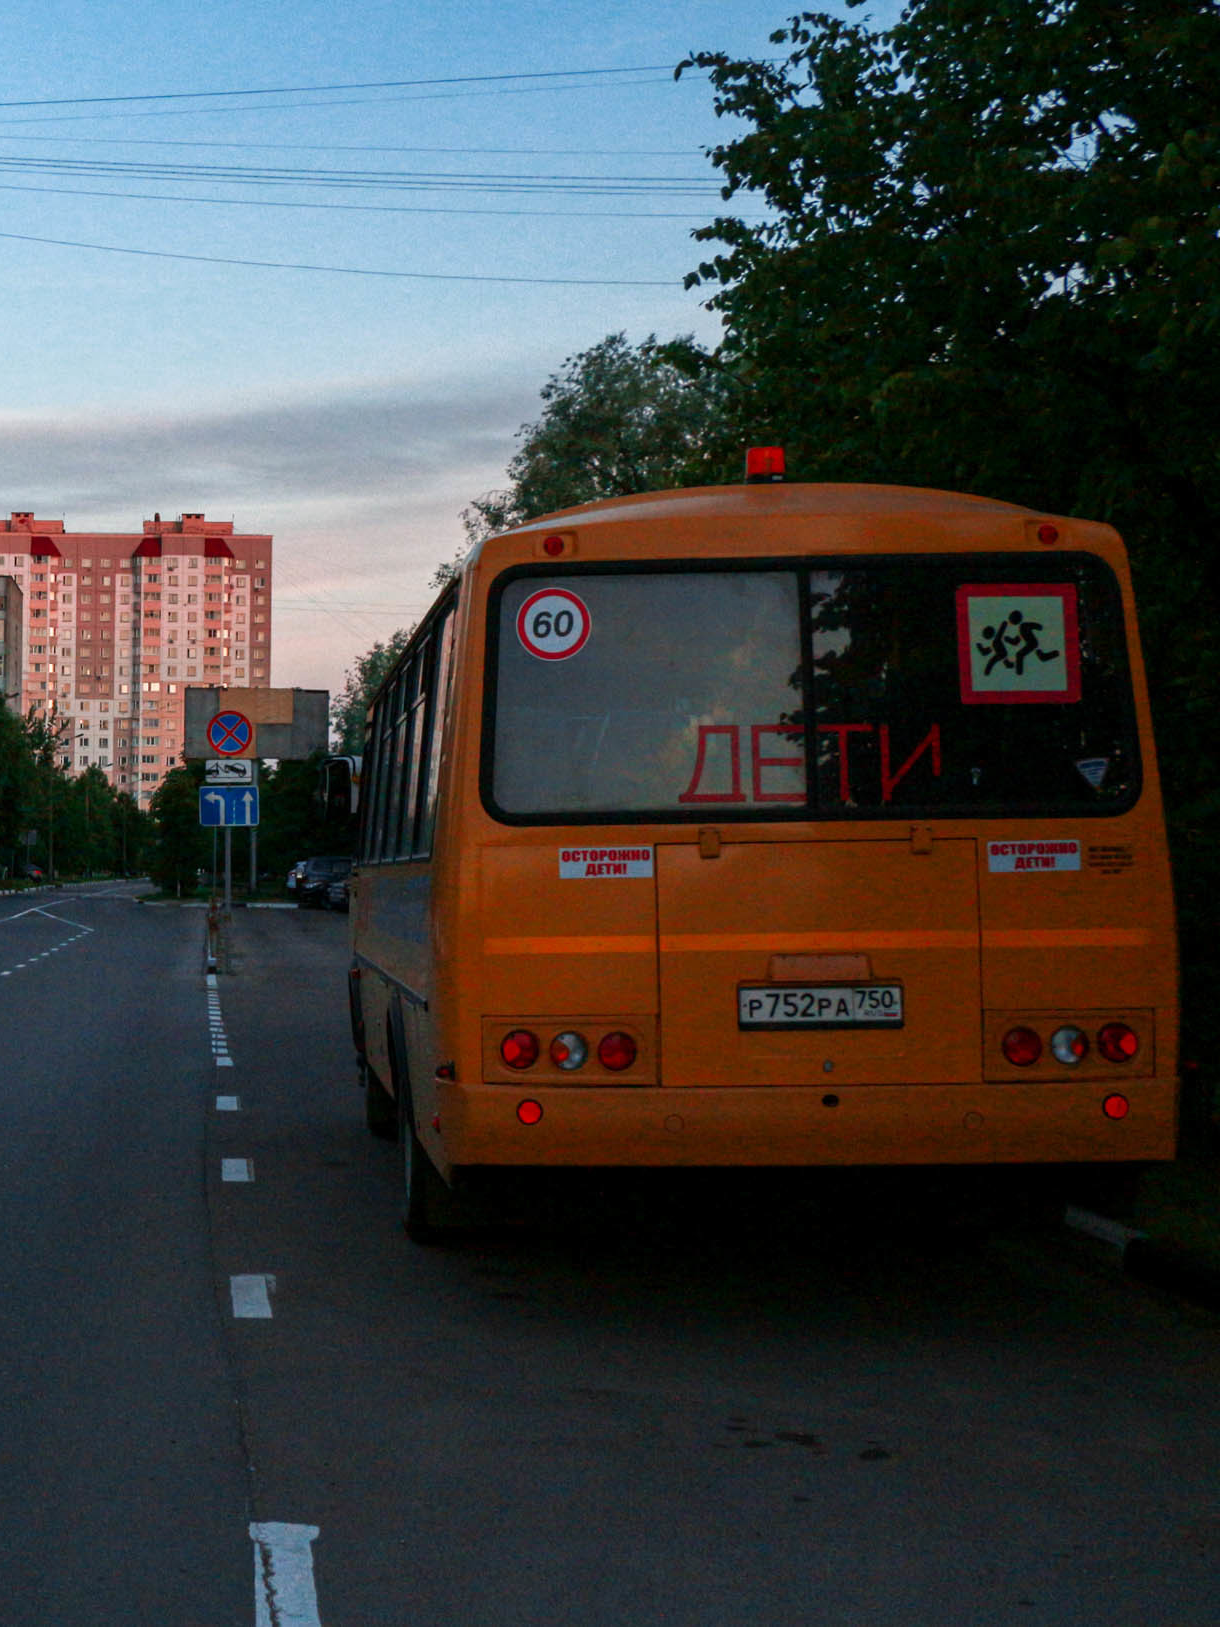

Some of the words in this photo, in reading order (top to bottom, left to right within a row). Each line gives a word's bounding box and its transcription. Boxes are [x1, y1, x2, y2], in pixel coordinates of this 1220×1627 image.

[533, 610, 574, 638] 60
[678, 723, 941, 802] ДЕТИ
[561, 849, 650, 862] ОСТОРОЖНО
[990, 842, 1078, 855] ОСТОРОЖНО
[585, 863, 628, 876] ДЕТИ!
[1014, 856, 1056, 870] ДЕТИ!
[855, 990, 894, 1009] 750
